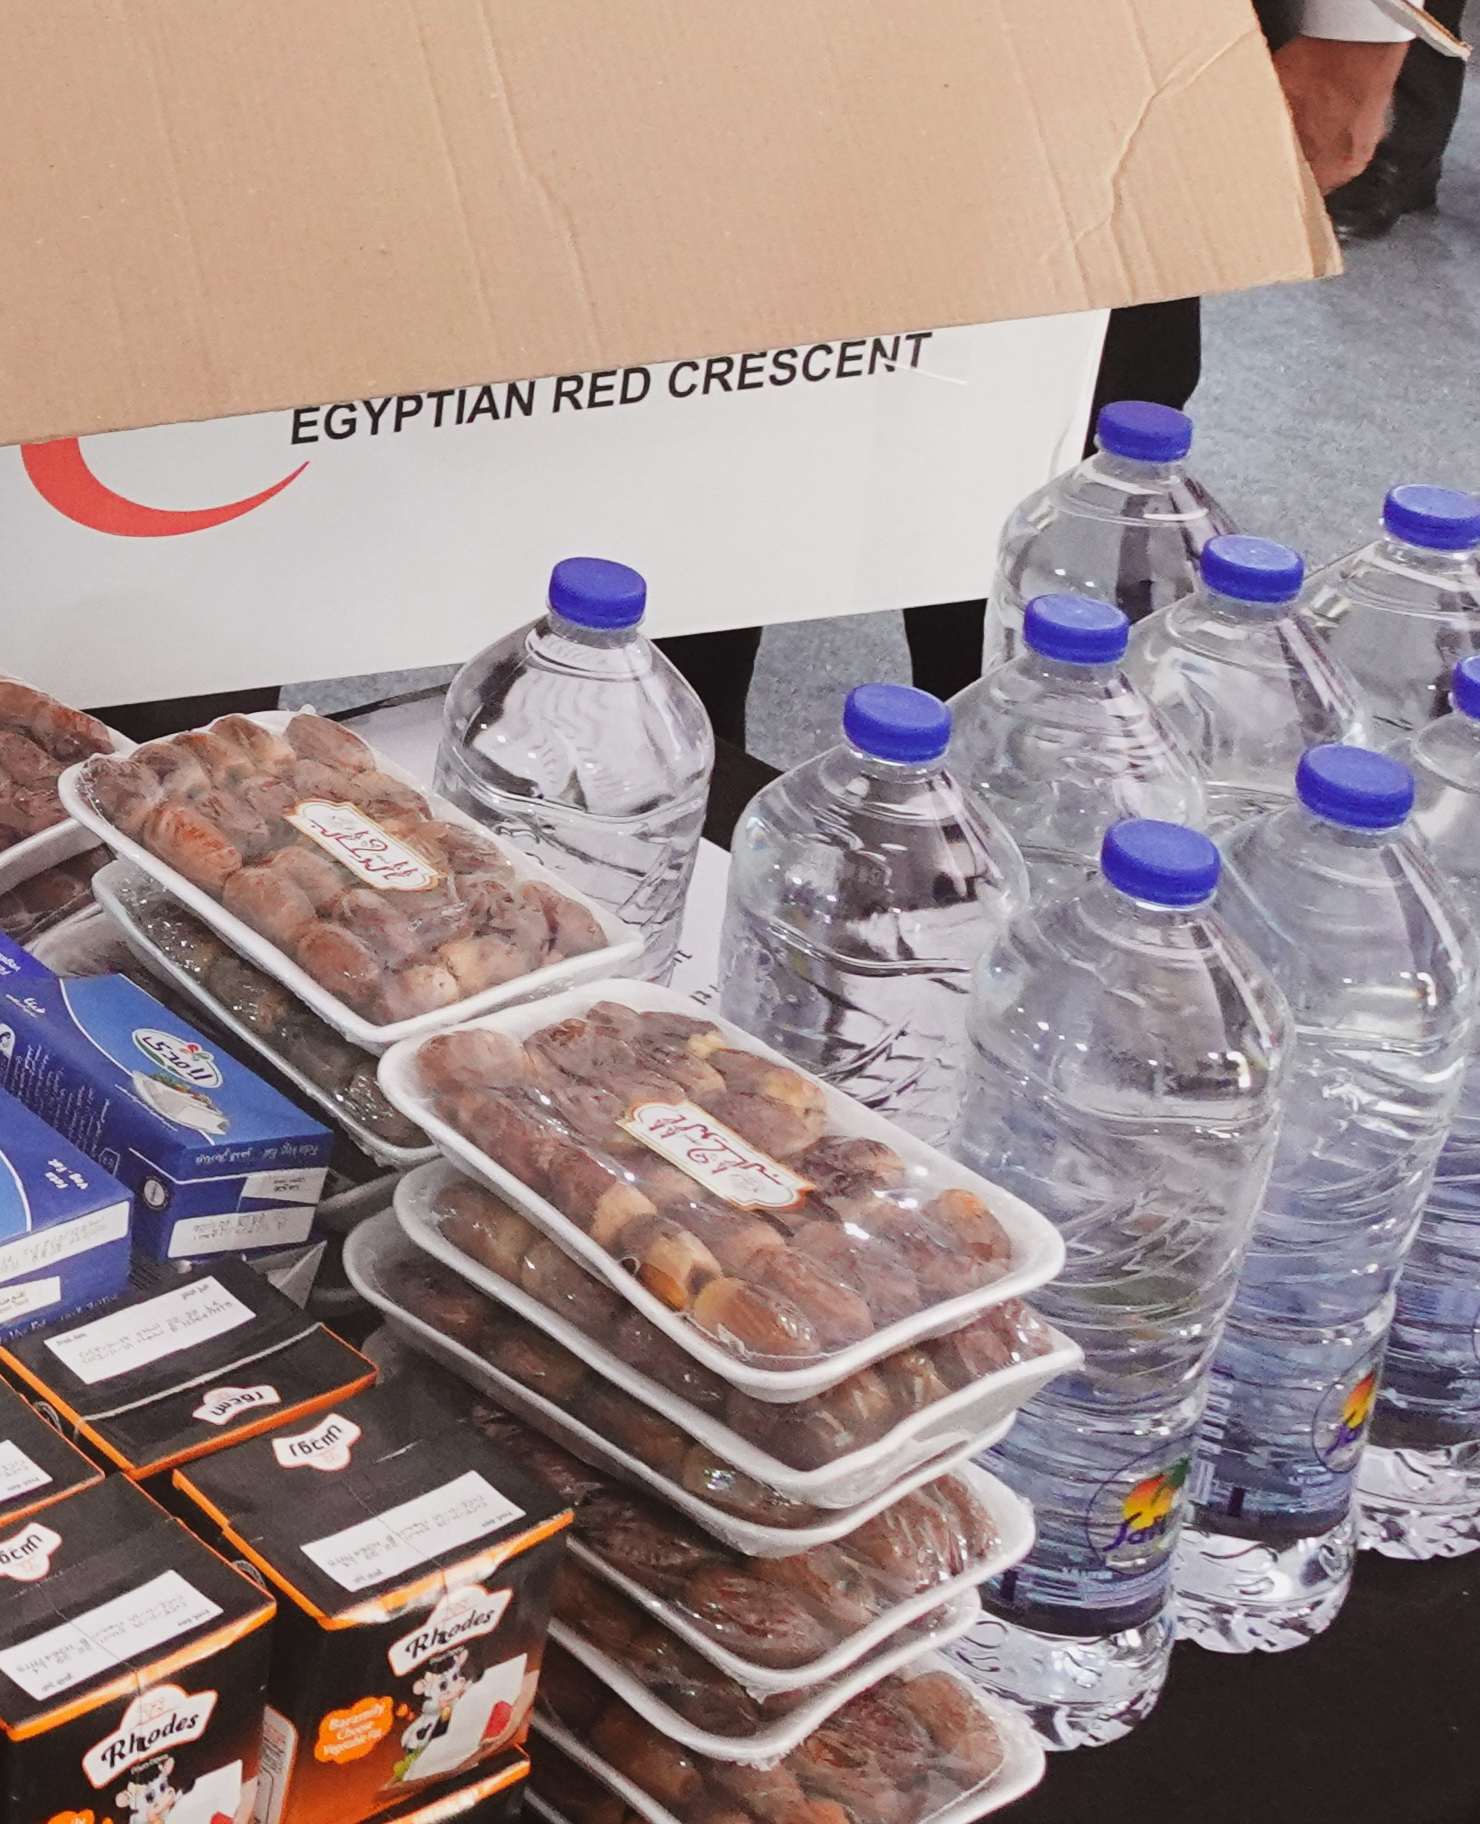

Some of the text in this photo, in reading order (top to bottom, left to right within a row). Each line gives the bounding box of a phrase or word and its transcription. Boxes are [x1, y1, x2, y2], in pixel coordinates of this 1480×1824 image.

[289, 330, 933, 448] EGYPTIAN RED CRESCENT
[405, 1607, 494, 1659] Rhodes
[101, 1710, 200, 1771] Rhodes
